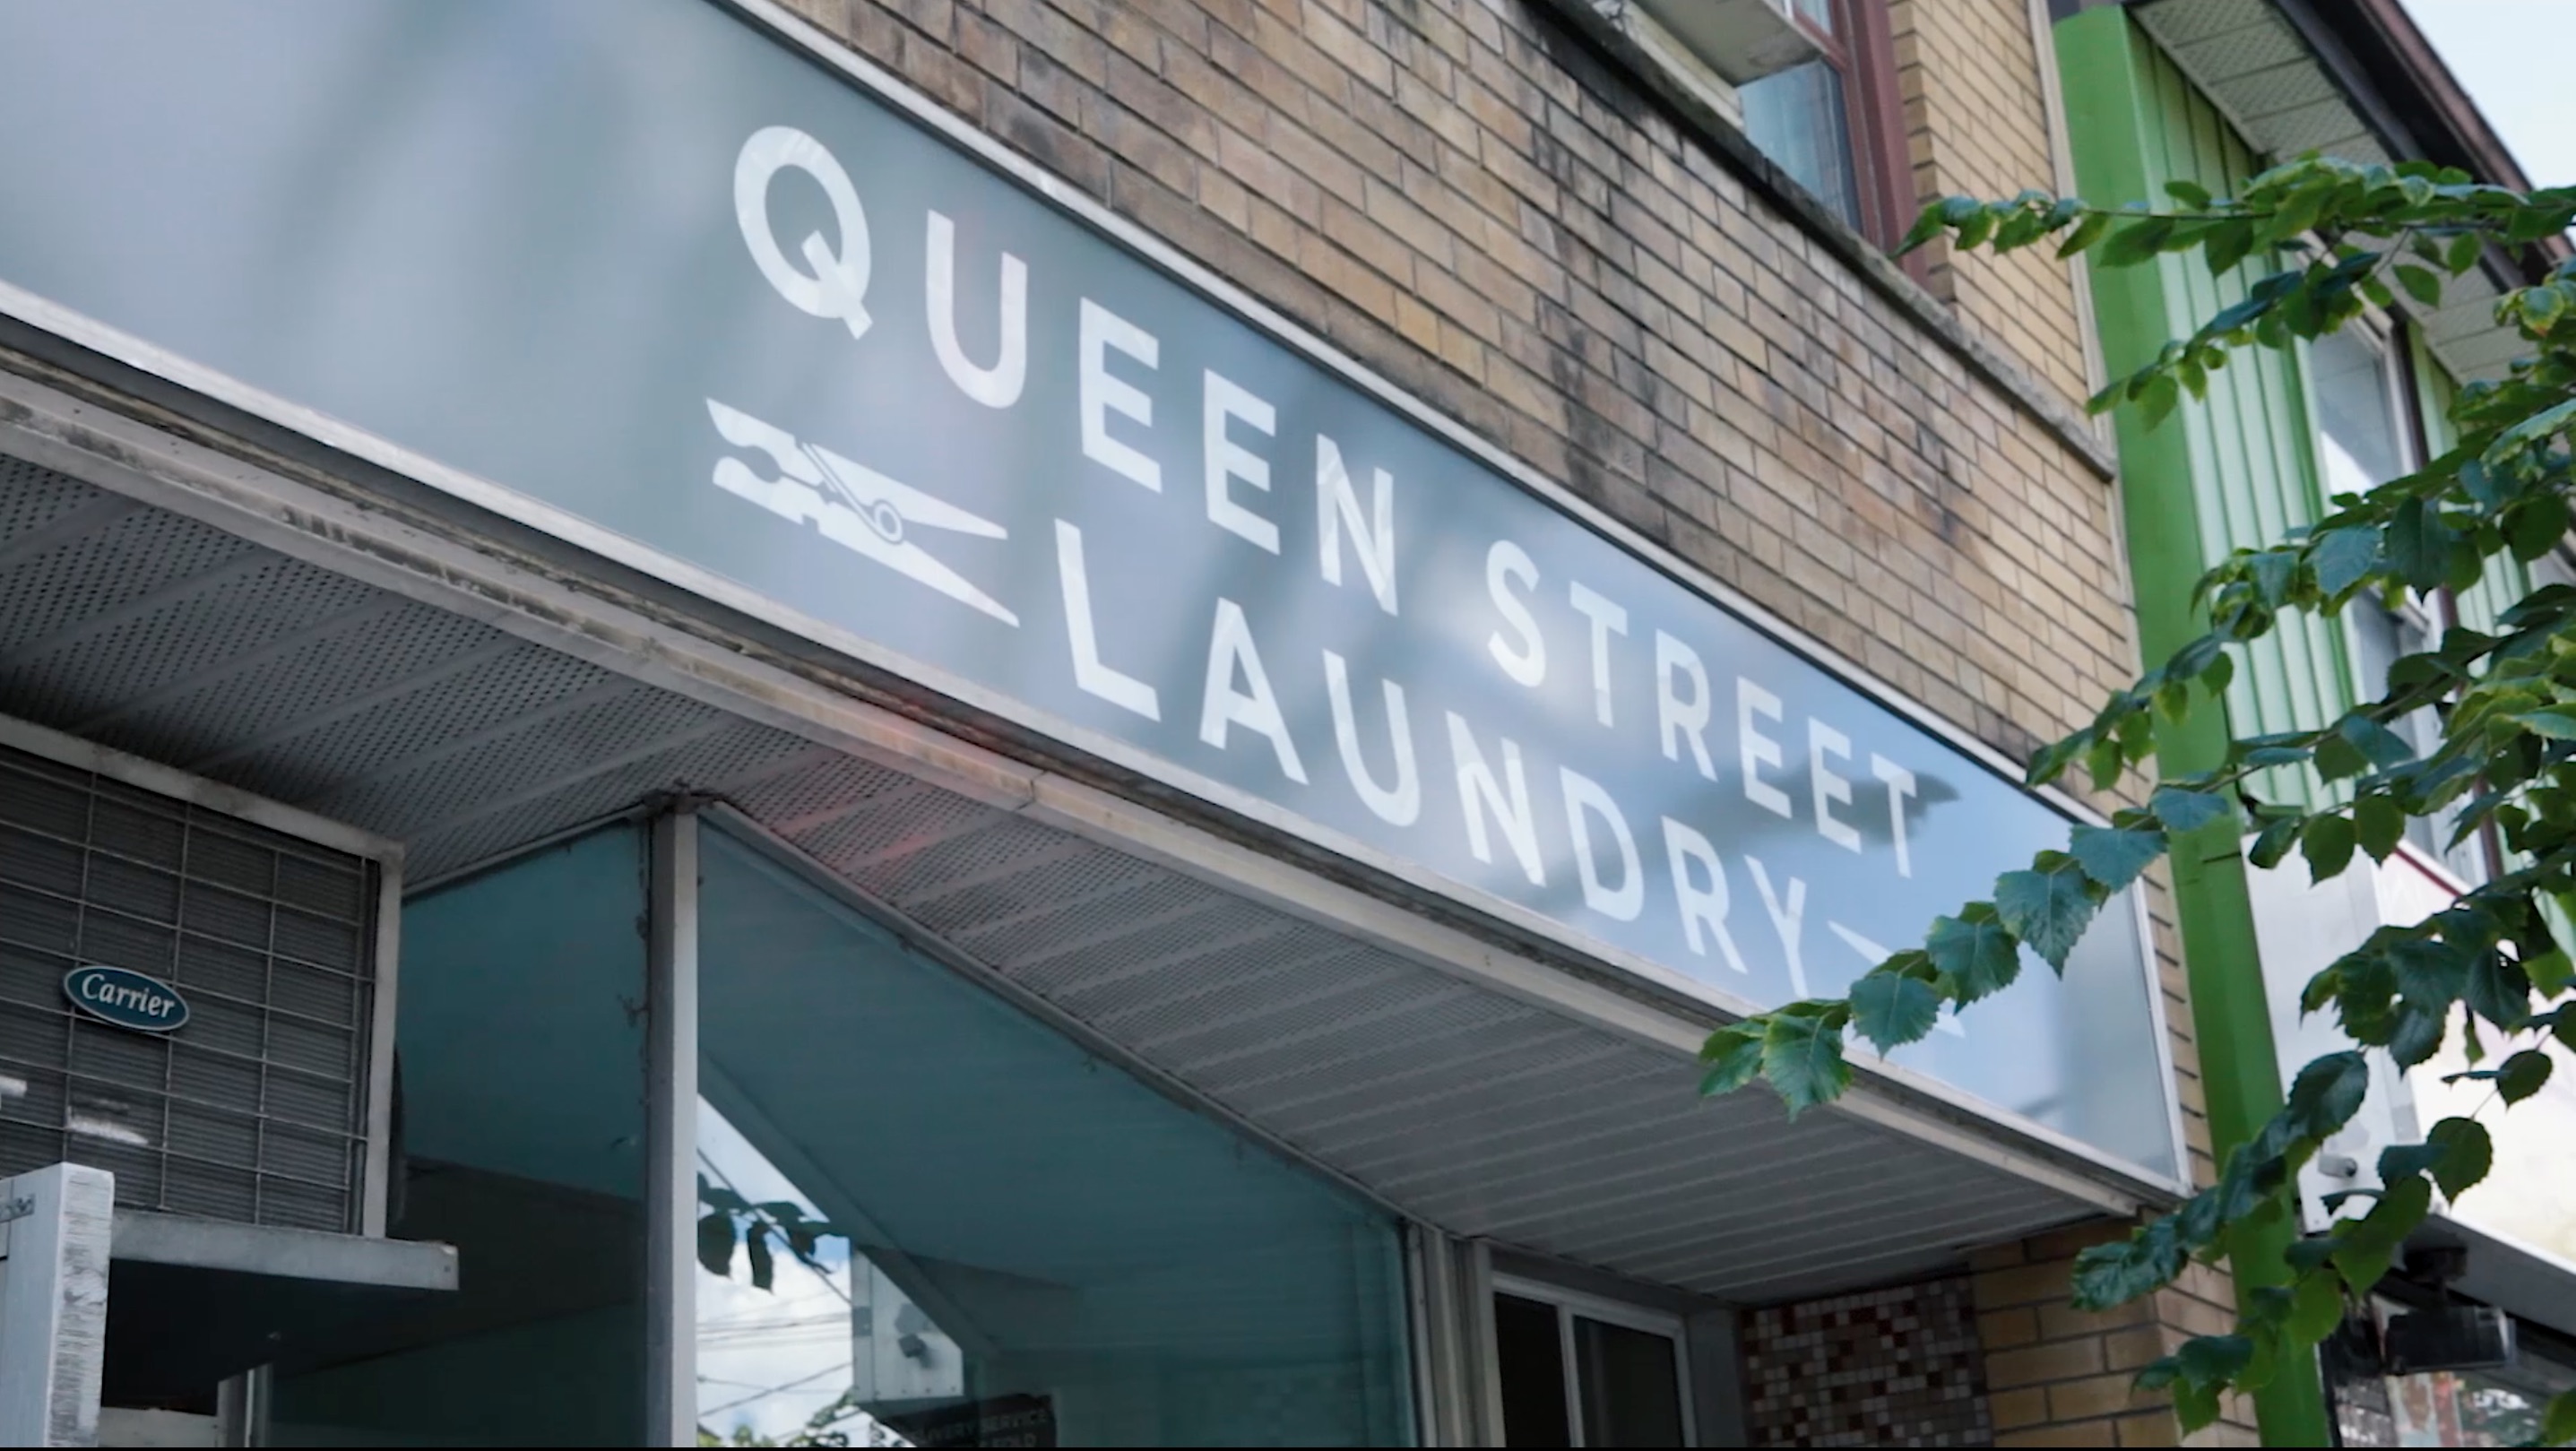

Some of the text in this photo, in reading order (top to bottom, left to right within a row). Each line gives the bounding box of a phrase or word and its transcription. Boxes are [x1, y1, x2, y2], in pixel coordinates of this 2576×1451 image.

[734, 125, 1916, 878] QUEEN STREET
[82, 973, 175, 1018] Carrier
[1055, 518, 1808, 999] LAUNDRY
